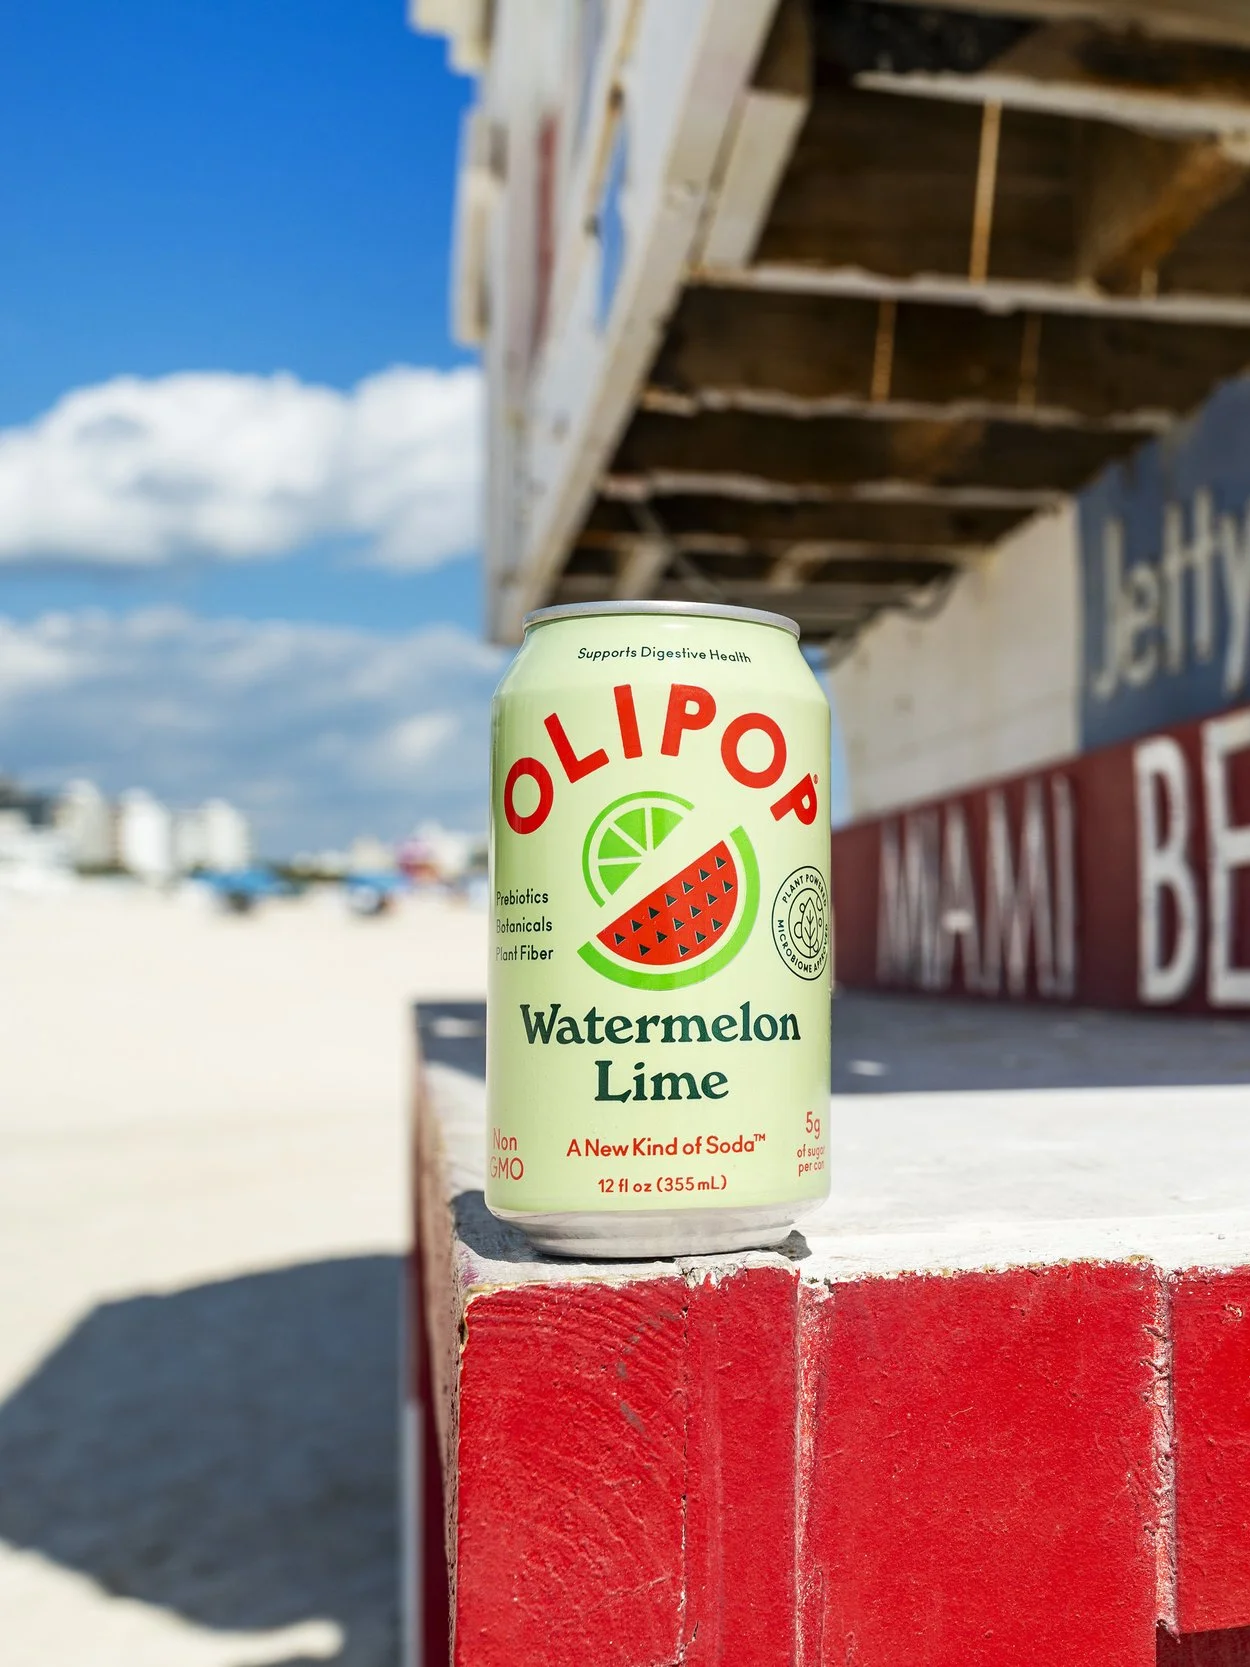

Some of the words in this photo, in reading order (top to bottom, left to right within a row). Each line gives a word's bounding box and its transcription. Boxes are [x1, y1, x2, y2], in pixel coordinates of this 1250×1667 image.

[577, 646, 637, 660] Supports
[641, 646, 706, 661] Digestive
[710, 649, 751, 663] Health
[496, 888, 549, 906] Prebiotics
[782, 875, 803, 903] PLANT
[876, 774, 1077, 1002] MIAMI
[496, 916, 553, 934] Botanicals
[496, 945, 518, 961] Plant
[520, 944, 554, 960] Fiber
[777, 919, 812, 973] MICROBIOME
[520, 1001, 801, 1045] Watermelon
[594, 1060, 729, 1103] Lime
[805, 1111, 821, 1140] 5g
[493, 1127, 518, 1152] Non
[566, 1140, 582, 1157] A
[585, 1138, 629, 1157] New
[632, 1137, 677, 1156] Kind
[682, 1136, 702, 1155] of
[797, 1143, 806, 1158] of
[798, 1162, 812, 1177] per
[598, 1179, 614, 1193] 12
[618, 1178, 629, 1193] fl
[632, 1182, 652, 1193] oz
[656, 1176, 695, 1193] (355
[697, 1174, 728, 1191] mL)
